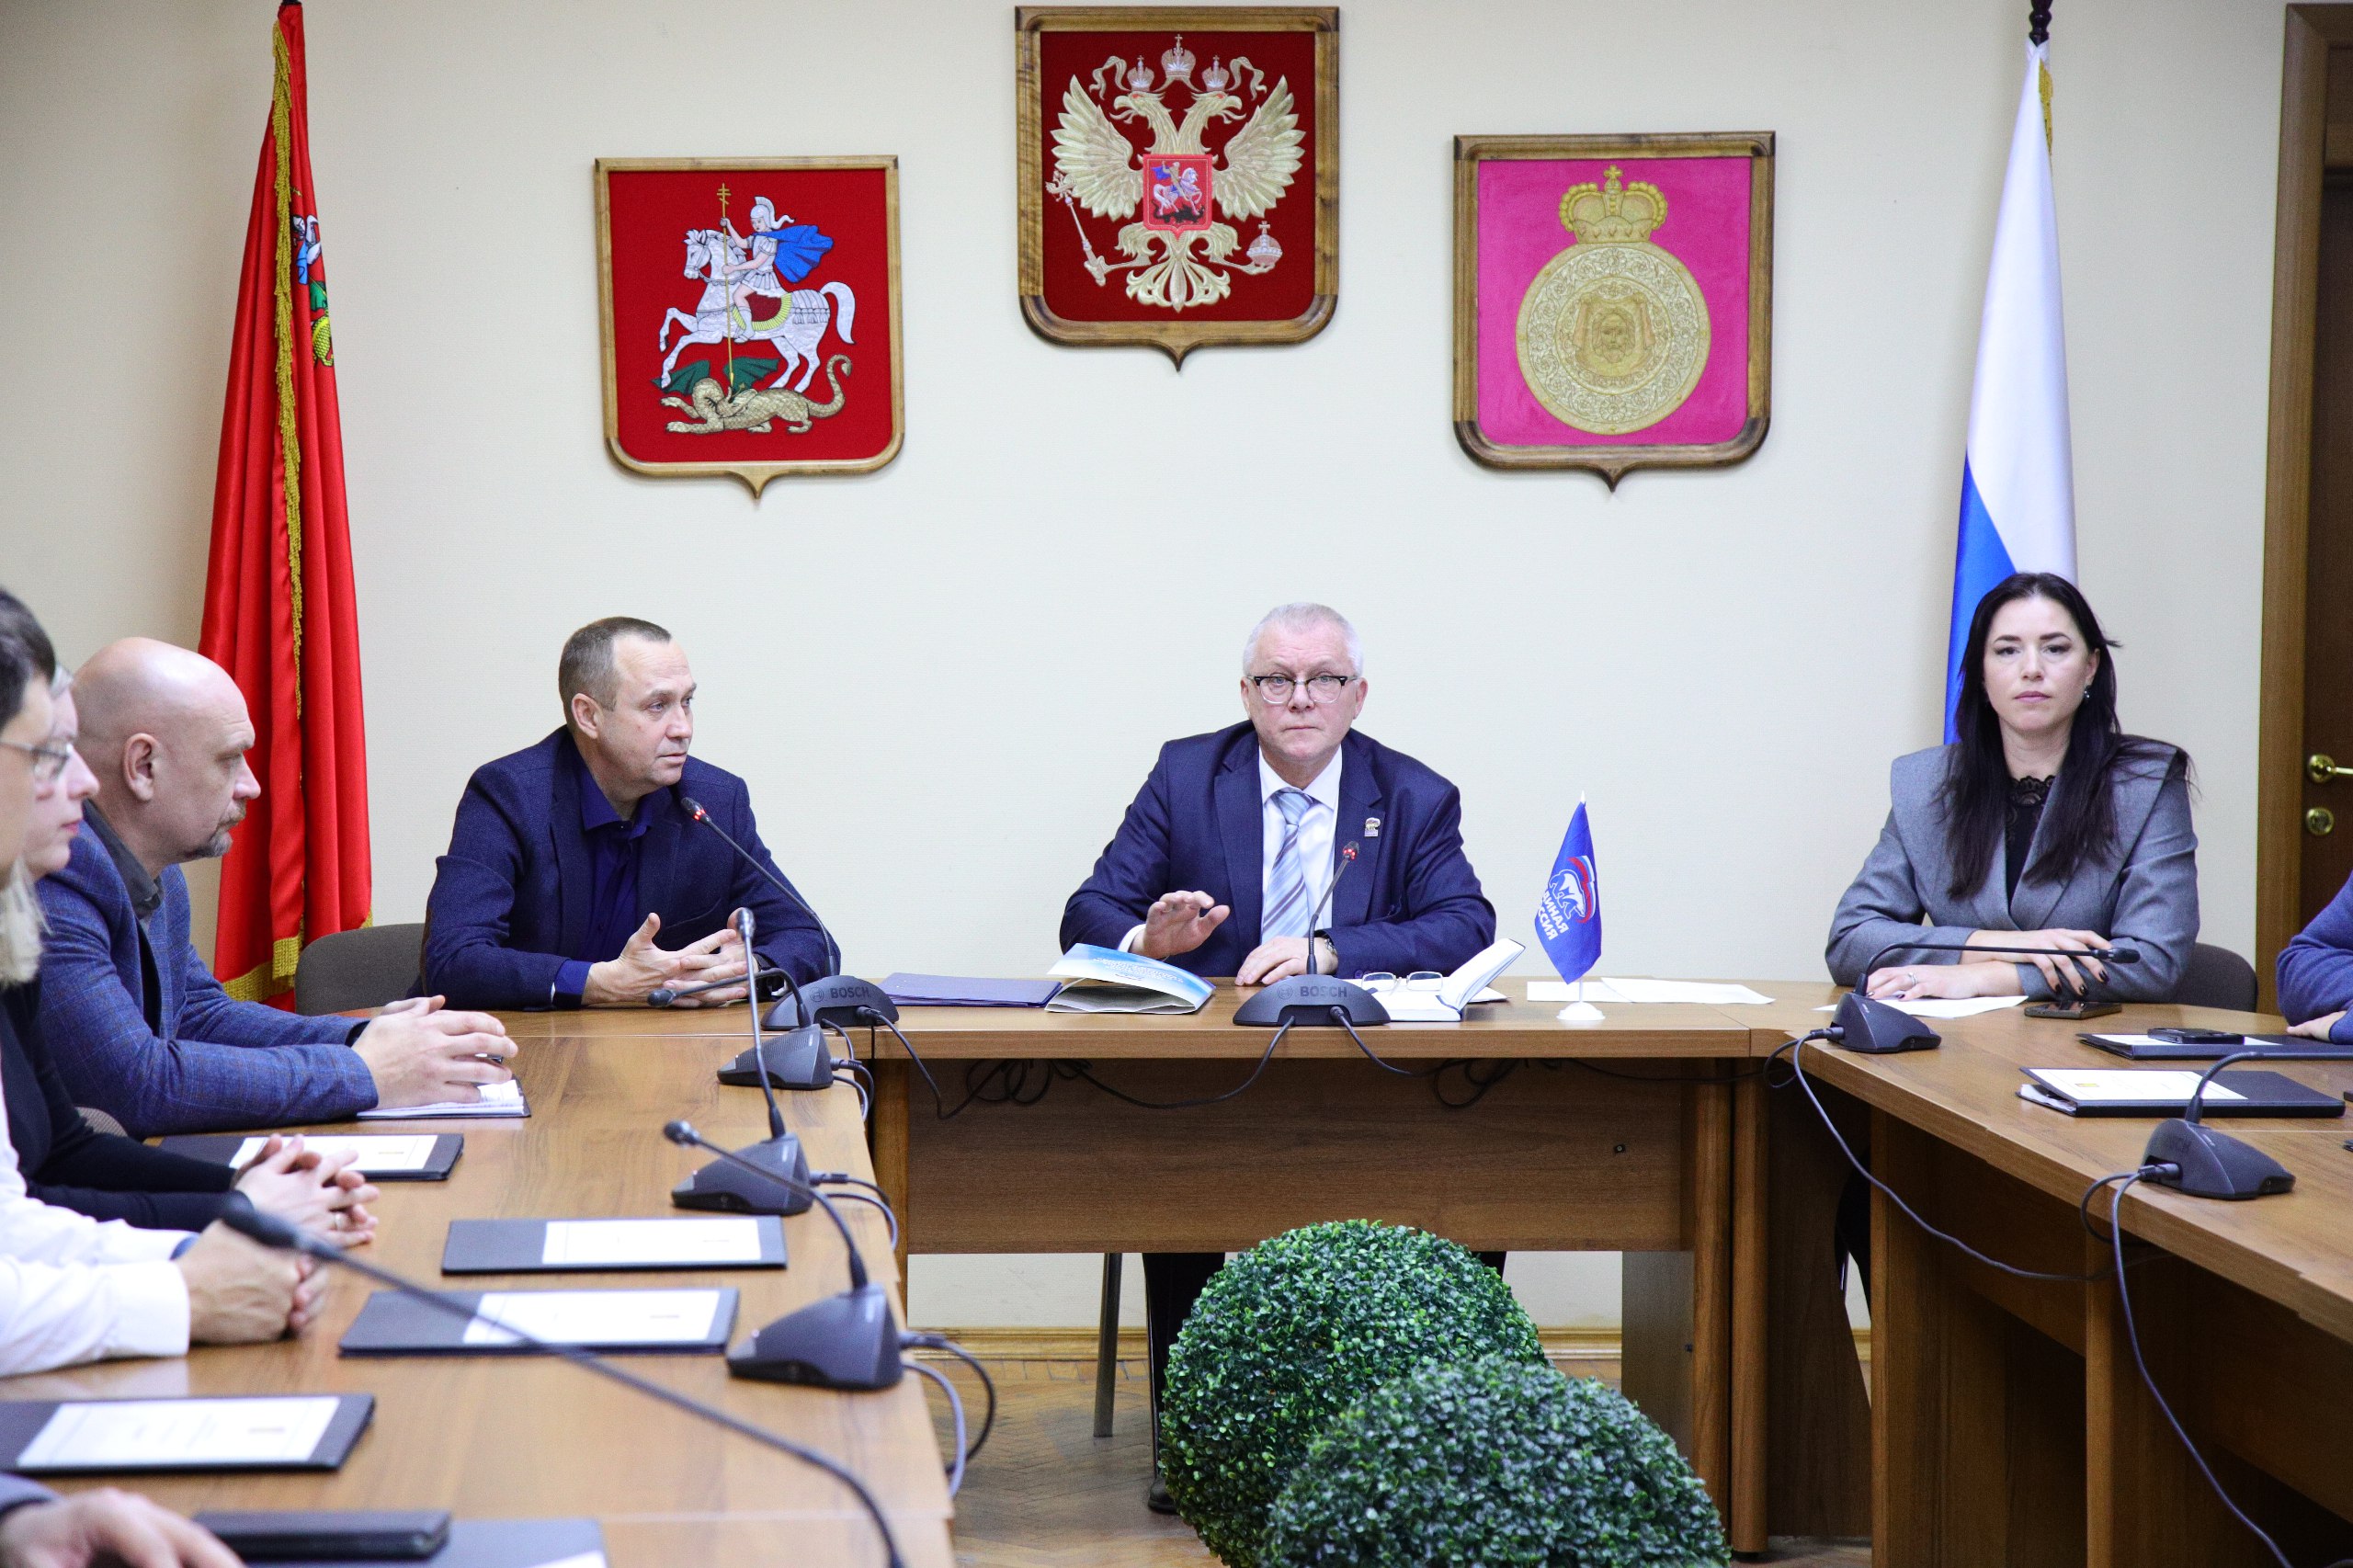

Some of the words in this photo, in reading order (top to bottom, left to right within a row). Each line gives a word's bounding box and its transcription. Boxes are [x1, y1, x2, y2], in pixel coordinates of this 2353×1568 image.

[1538, 904, 1559, 940] ССИЯ
[1543, 891, 1569, 933] ДИНАЯ
[829, 986, 870, 999] BOSCH
[1300, 985, 1347, 997] BOSCH
